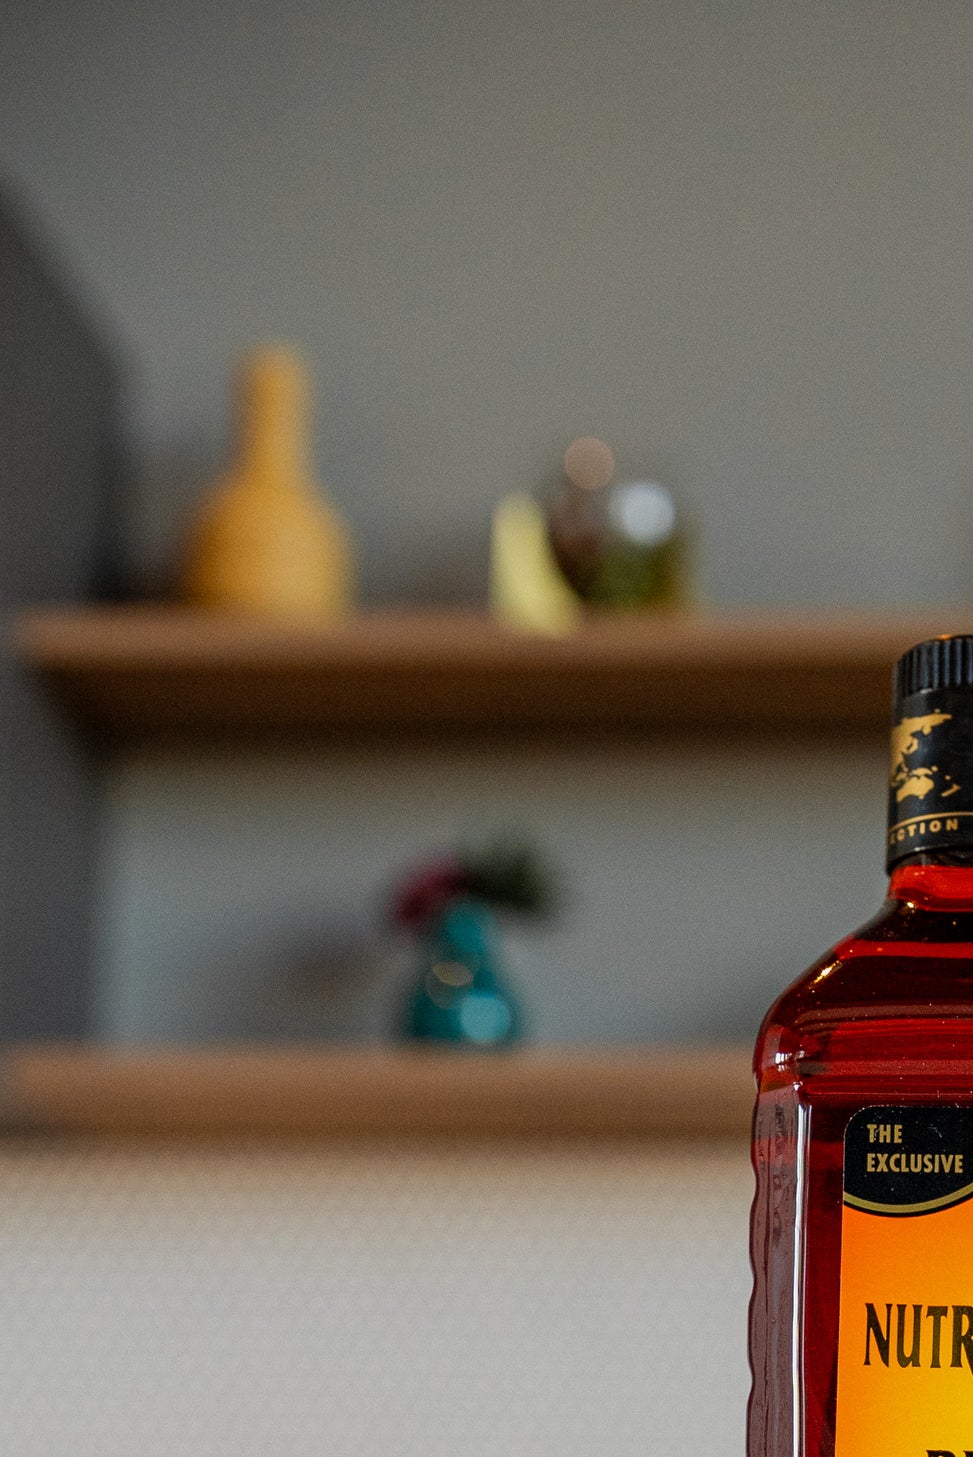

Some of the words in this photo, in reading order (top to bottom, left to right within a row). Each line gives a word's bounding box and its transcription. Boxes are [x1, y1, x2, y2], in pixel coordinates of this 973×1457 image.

[889, 818, 959, 844] CTION
[866, 1124, 903, 1144] THE
[866, 1153, 964, 1174] EXCLUSIVE
